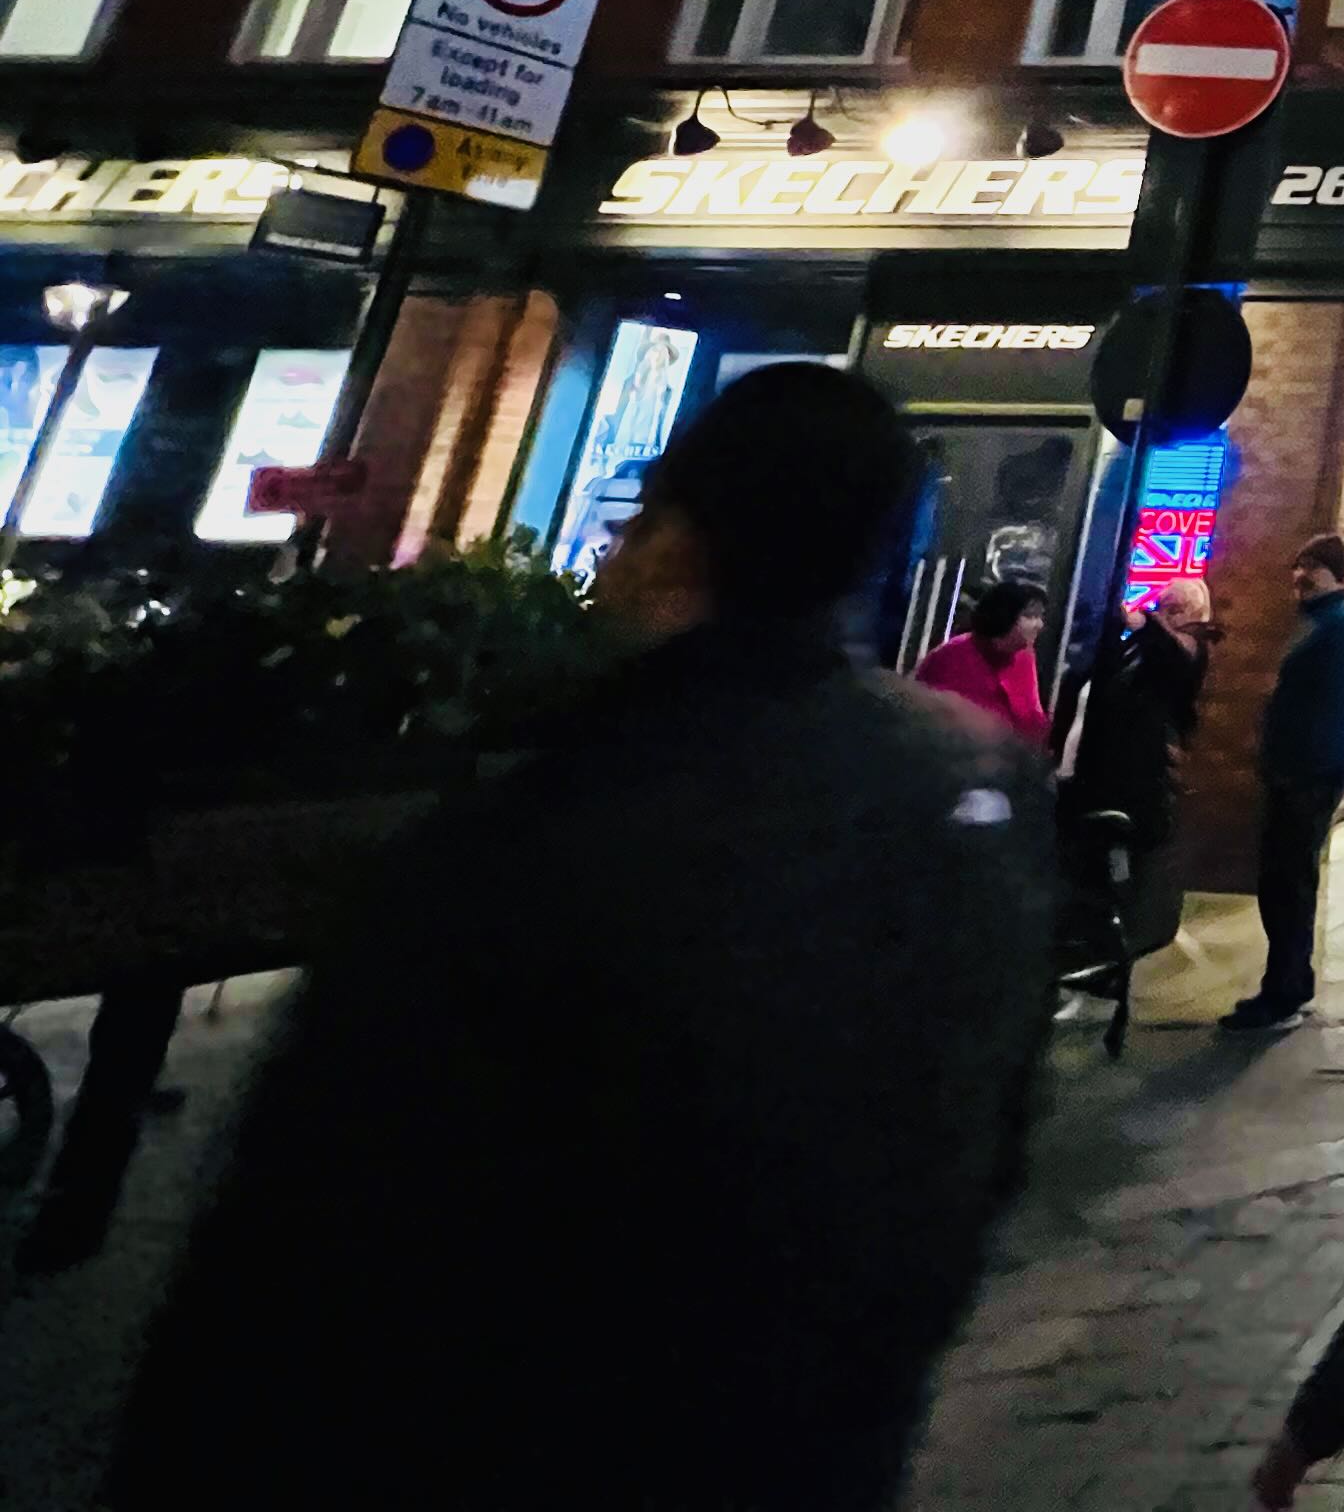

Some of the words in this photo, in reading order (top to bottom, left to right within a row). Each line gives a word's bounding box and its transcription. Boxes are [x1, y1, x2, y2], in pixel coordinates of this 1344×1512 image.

[437, 0, 469, 27] No
[477, 13, 562, 56] vehicles
[430, 39, 512, 82] Except
[439, 65, 522, 108] loading
[597, 159, 1147, 215] SKECHERS
[884, 323, 1095, 350] SKECHERS
